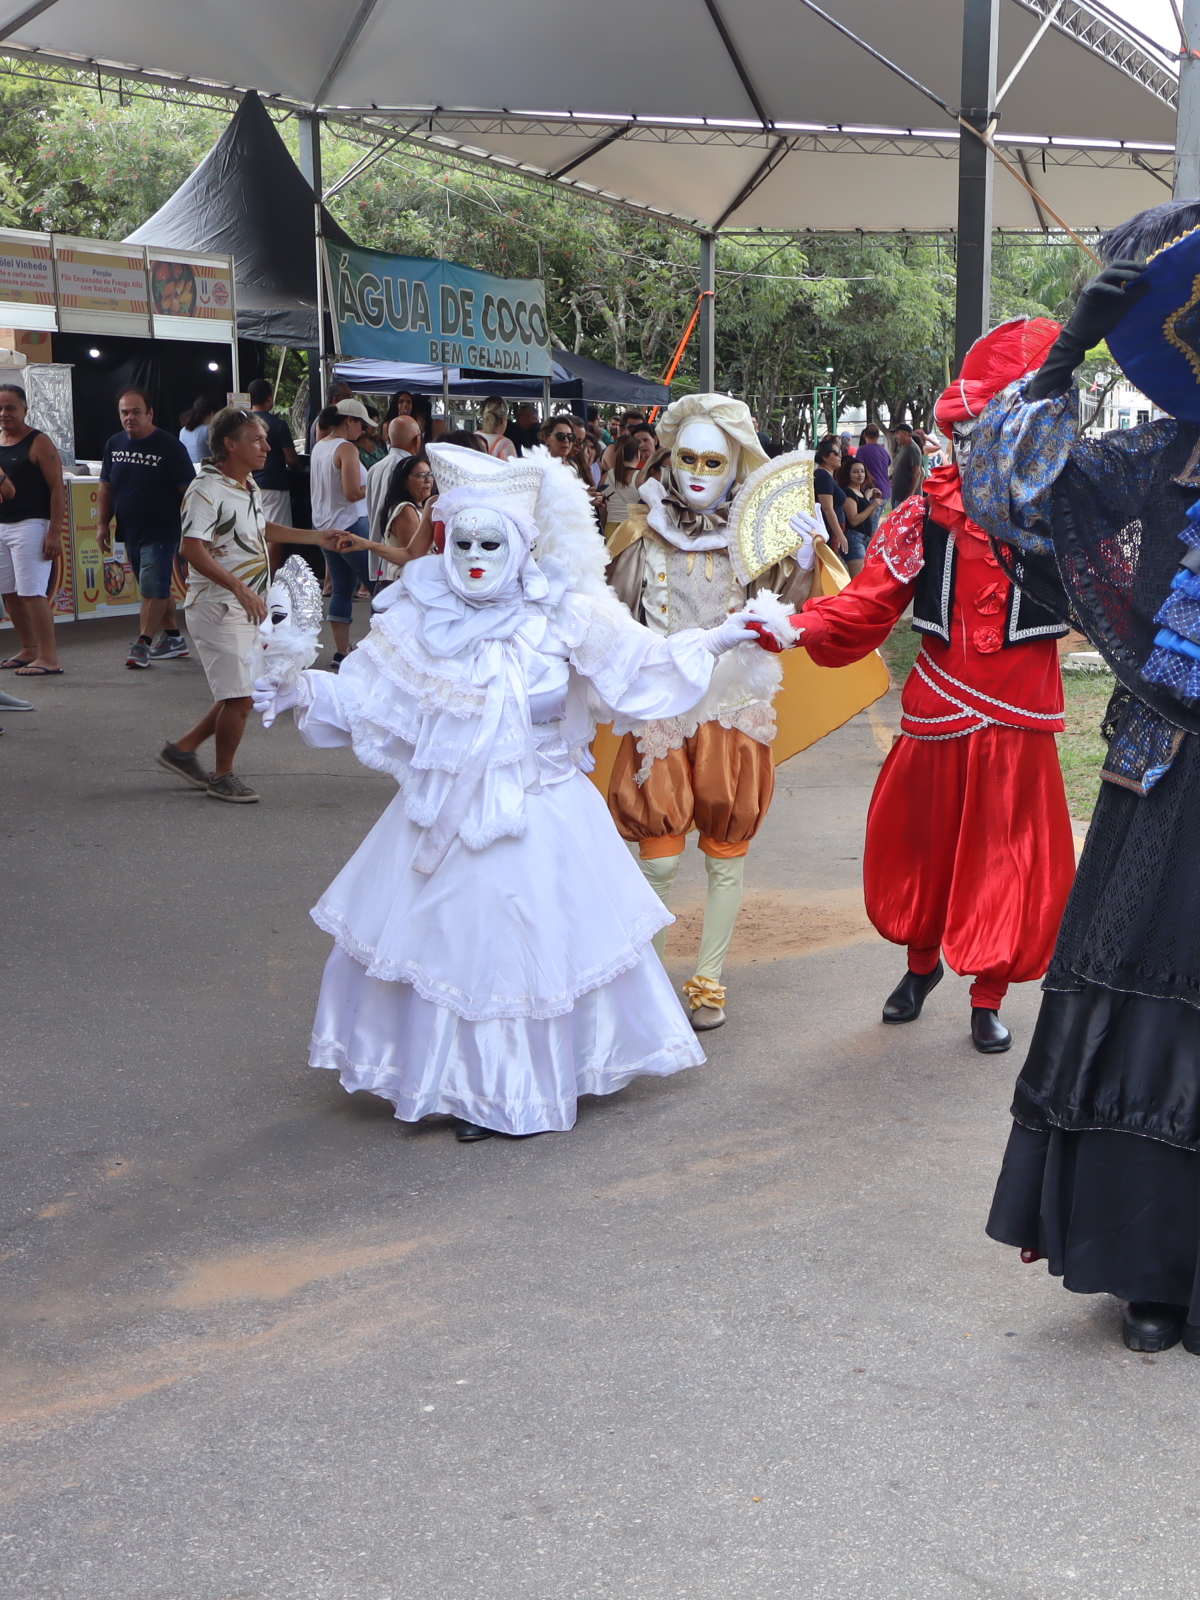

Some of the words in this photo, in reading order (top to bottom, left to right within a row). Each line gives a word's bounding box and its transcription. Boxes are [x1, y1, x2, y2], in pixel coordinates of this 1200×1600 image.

[15, 259, 48, 271] Vinhedo
[32, 273, 48, 281] sabor
[92, 268, 112, 278] Porção
[73, 274, 102, 284] Empanado
[112, 278, 131, 288] Frango
[94, 285, 112, 293] Batata
[113, 286, 127, 295] Frita
[337, 253, 432, 334] ÁGUA
[439, 284, 476, 338] DE
[481, 293, 550, 348] COCO
[428, 339, 464, 365] BEM
[467, 343, 521, 372] GELADA
[111, 450, 162, 467] TOMMY
